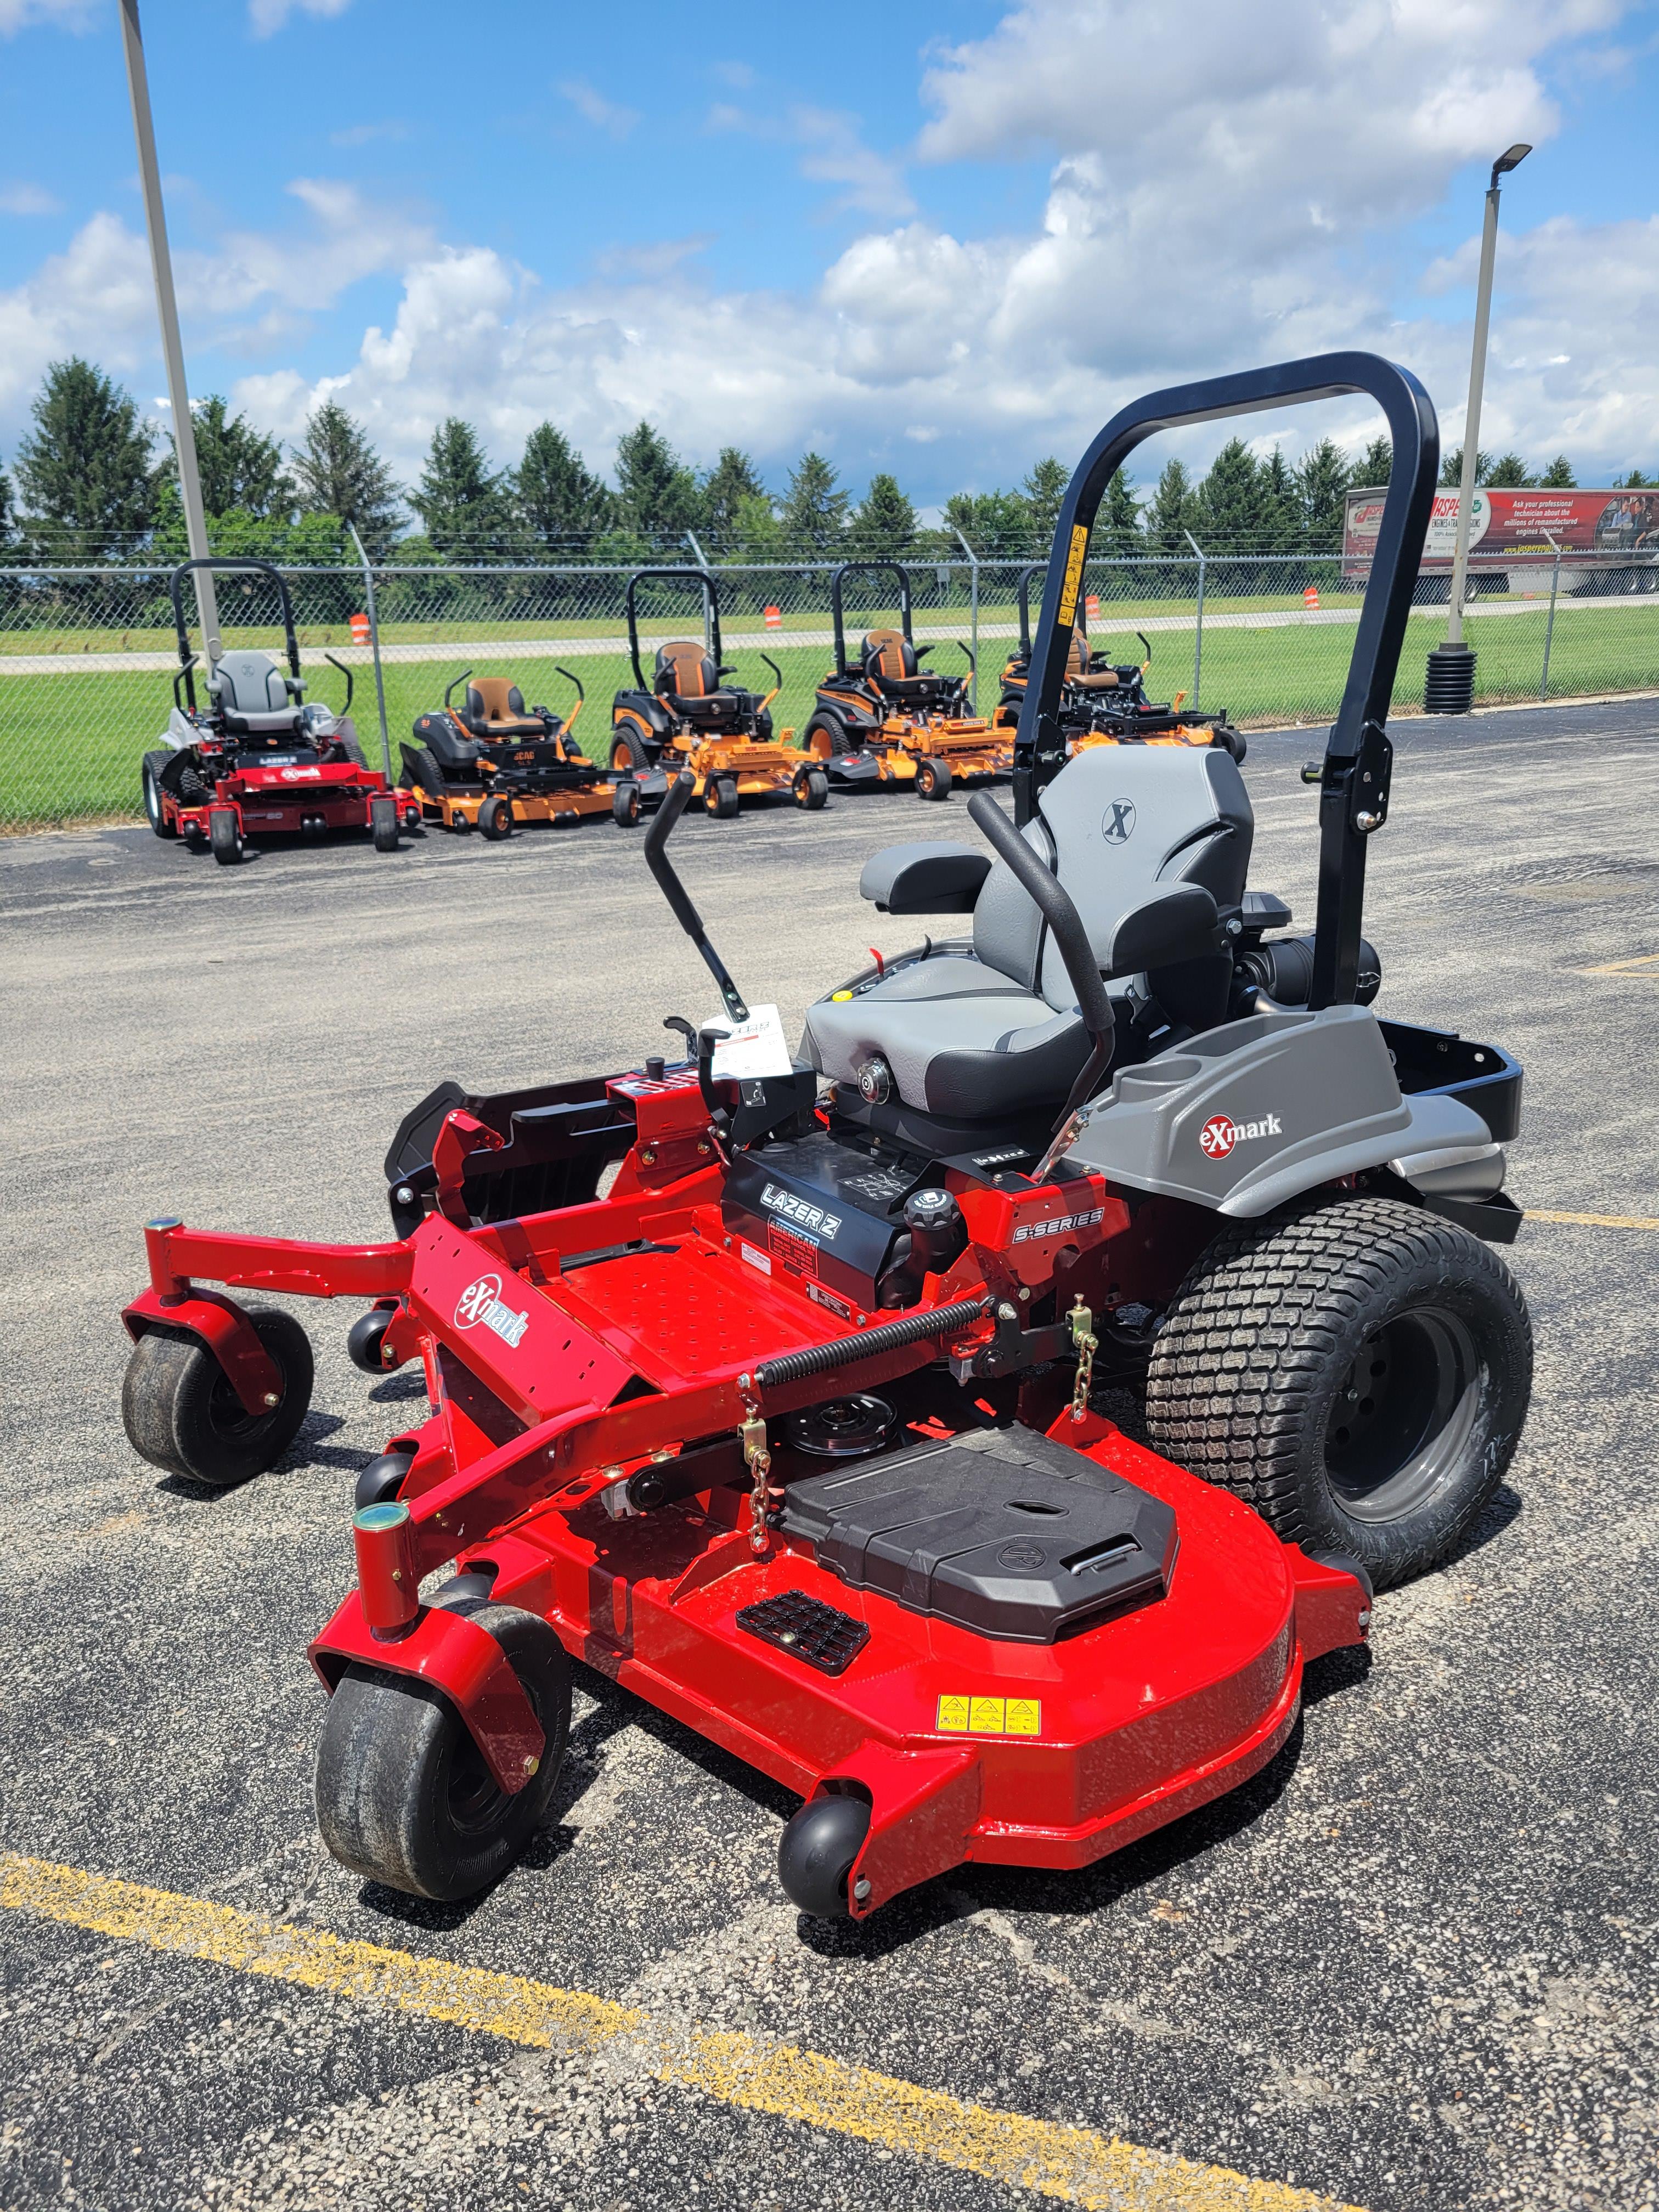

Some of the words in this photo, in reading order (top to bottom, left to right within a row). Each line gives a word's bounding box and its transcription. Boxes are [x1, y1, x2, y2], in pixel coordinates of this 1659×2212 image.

[1430, 496, 1460, 517] ASPE
[1538, 500, 1573, 509] professional
[1432, 518, 1448, 528] ENGINES
[1504, 543, 1572, 554] www.jasperengis.com
[514, 752, 535, 761] SCAG
[1200, 1113, 1283, 1153] eXmark
[761, 1184, 823, 1231] LAZER
[819, 1214, 842, 1239] Z
[1013, 1207, 1104, 1244] S-SERIES
[459, 1282, 527, 1345] eXmark
